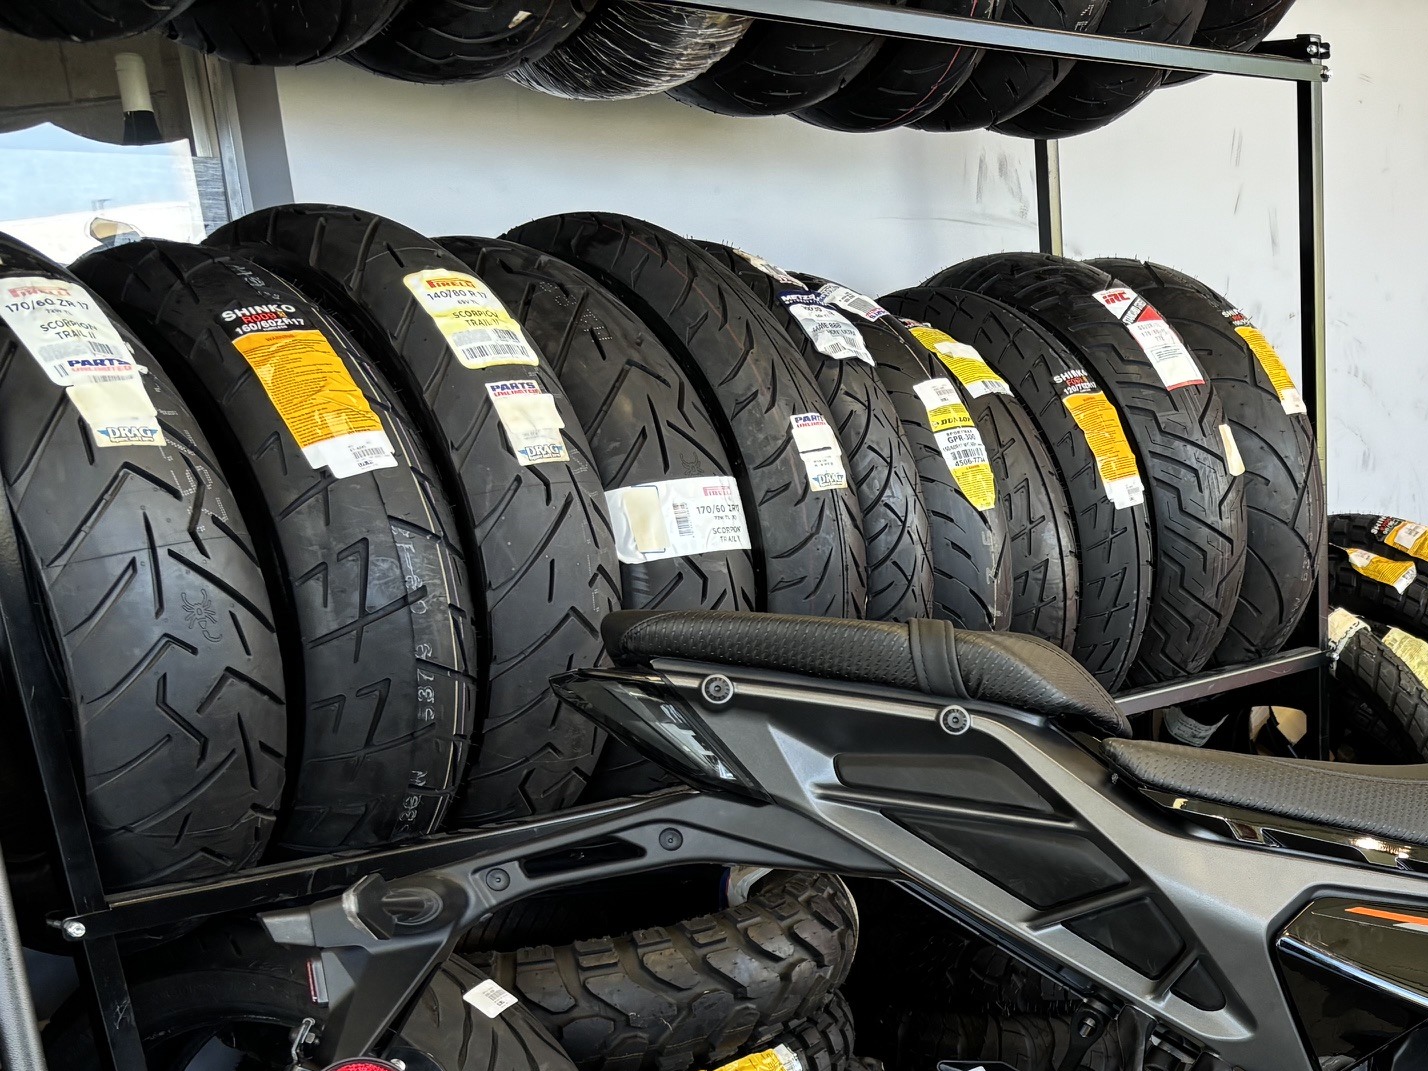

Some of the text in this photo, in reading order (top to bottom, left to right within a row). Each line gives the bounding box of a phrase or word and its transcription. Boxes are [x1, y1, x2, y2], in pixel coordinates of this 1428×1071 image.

[426, 278, 476, 289] PIRELLI
[427, 290, 467, 301] 140/80
[5, 298, 54, 313] 170/60
[221, 303, 296, 322] SHINKO
[40, 317, 97, 332] SCORPION
[57, 328, 88, 340] TRAIL
[67, 358, 131, 367] PARTS
[490, 382, 536, 392] PARTS
[107, 426, 151, 438] DRAG
[696, 504, 726, 515] 170/60
